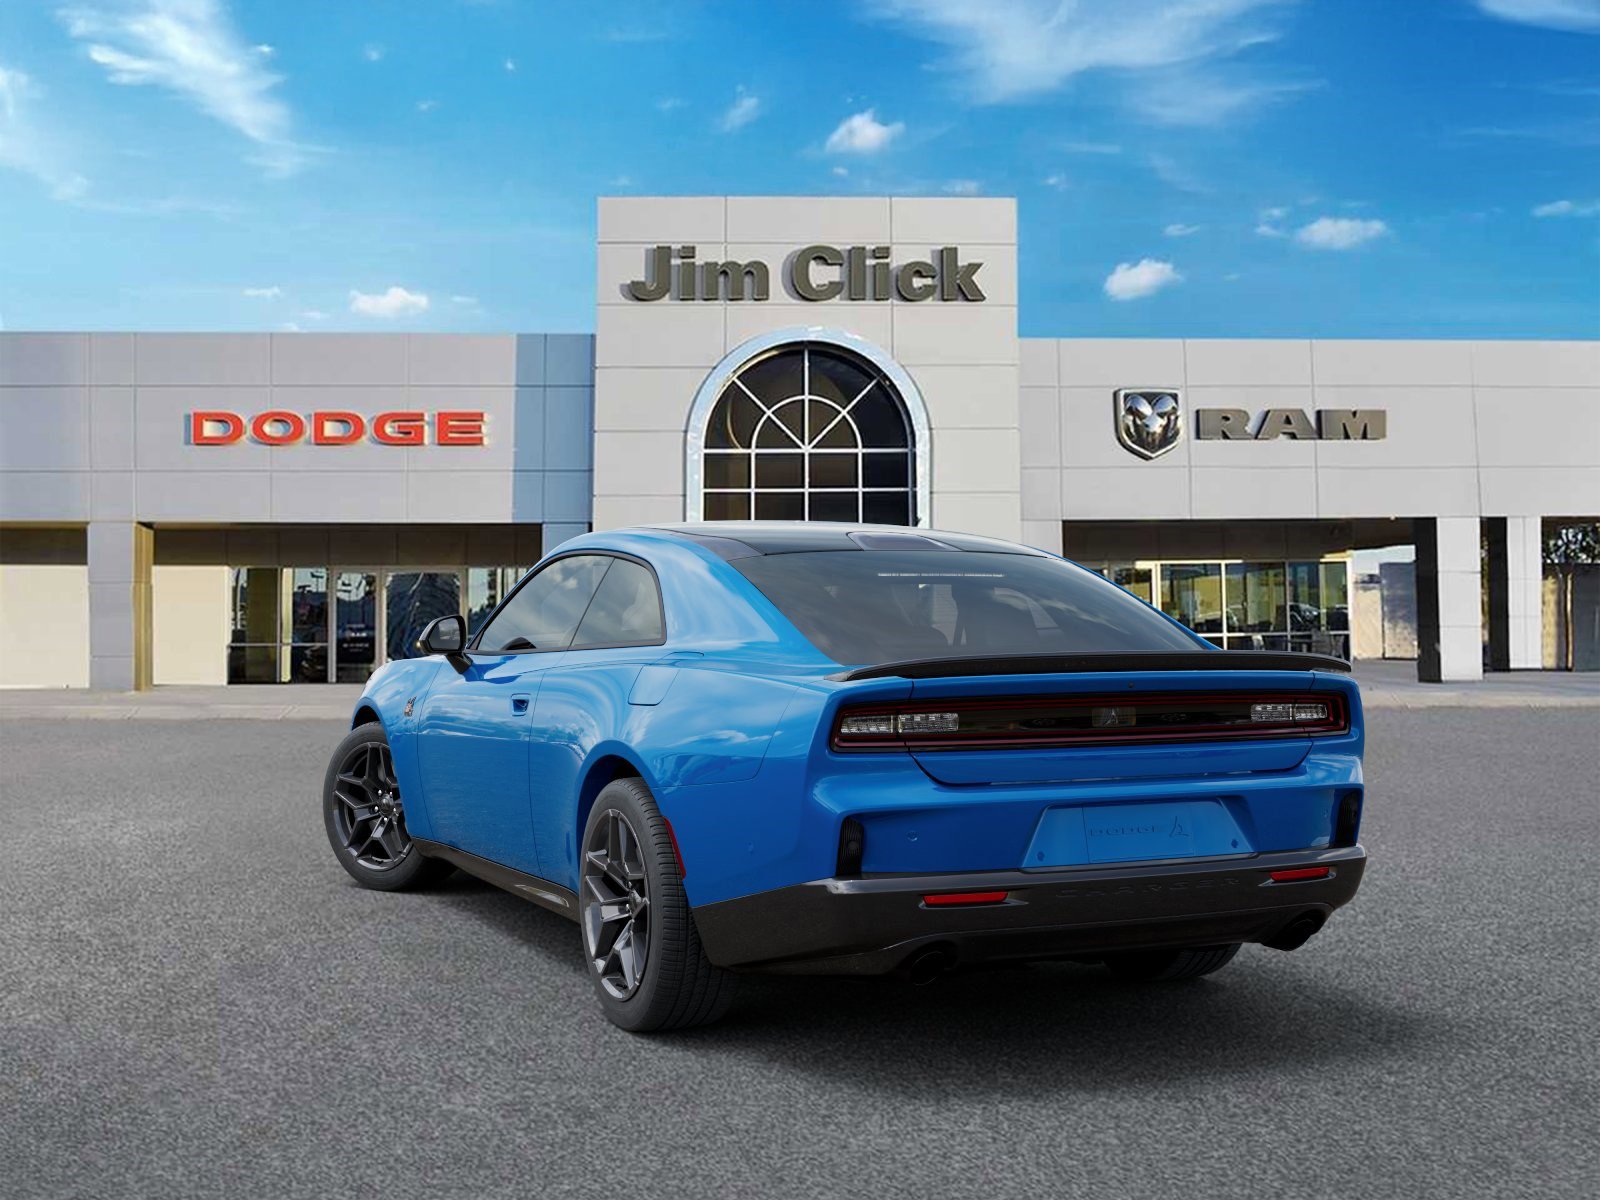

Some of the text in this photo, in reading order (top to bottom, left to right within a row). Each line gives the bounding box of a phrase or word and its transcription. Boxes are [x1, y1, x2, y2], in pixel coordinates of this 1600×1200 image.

[625, 244, 986, 302] Jim Click
[190, 411, 486, 446] DODGE
[1195, 408, 1387, 440] RAM
